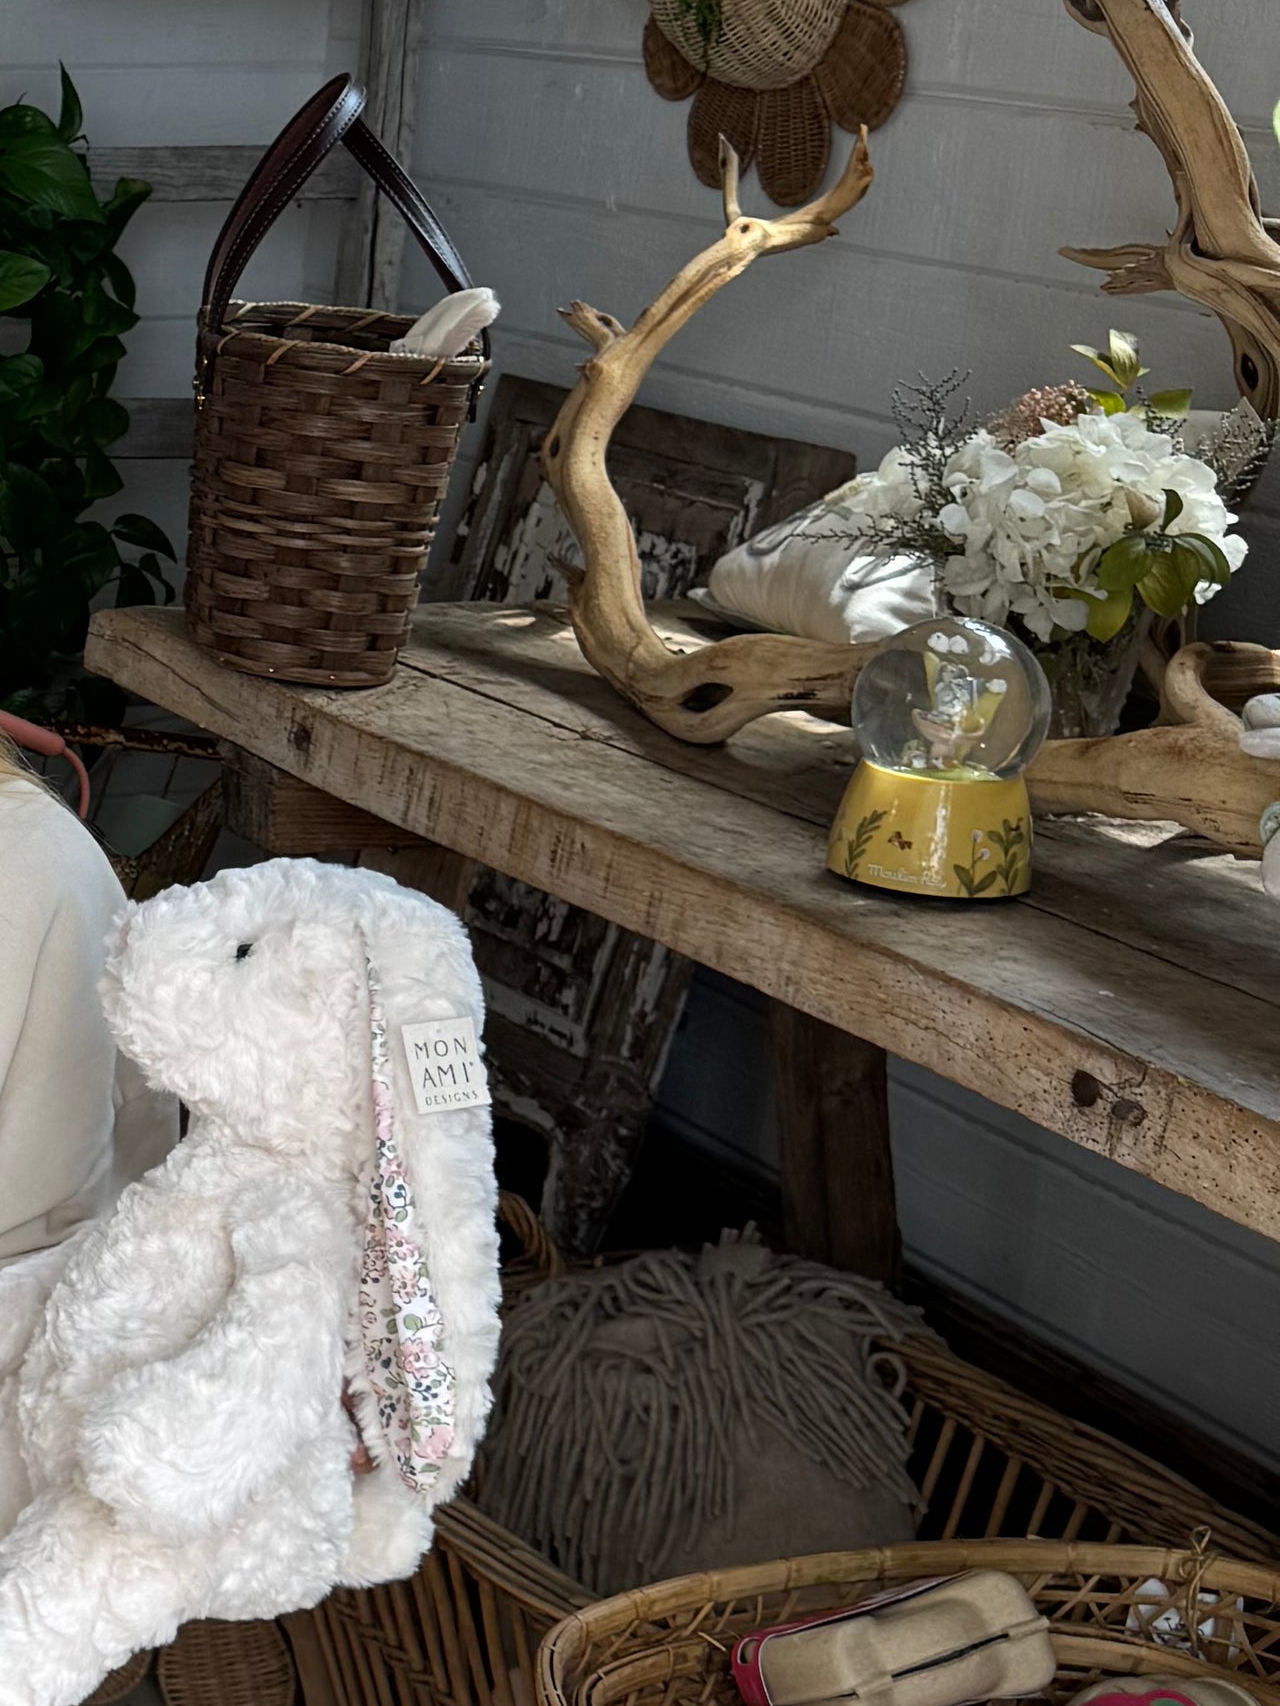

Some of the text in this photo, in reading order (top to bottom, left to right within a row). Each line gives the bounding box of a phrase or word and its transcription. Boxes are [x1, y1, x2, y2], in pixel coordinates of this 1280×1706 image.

[867, 863, 918, 884] Moulin
[413, 1035, 468, 1061] MON
[422, 1061, 470, 1089] AMI
[425, 1089, 479, 1107] DESIGNS
